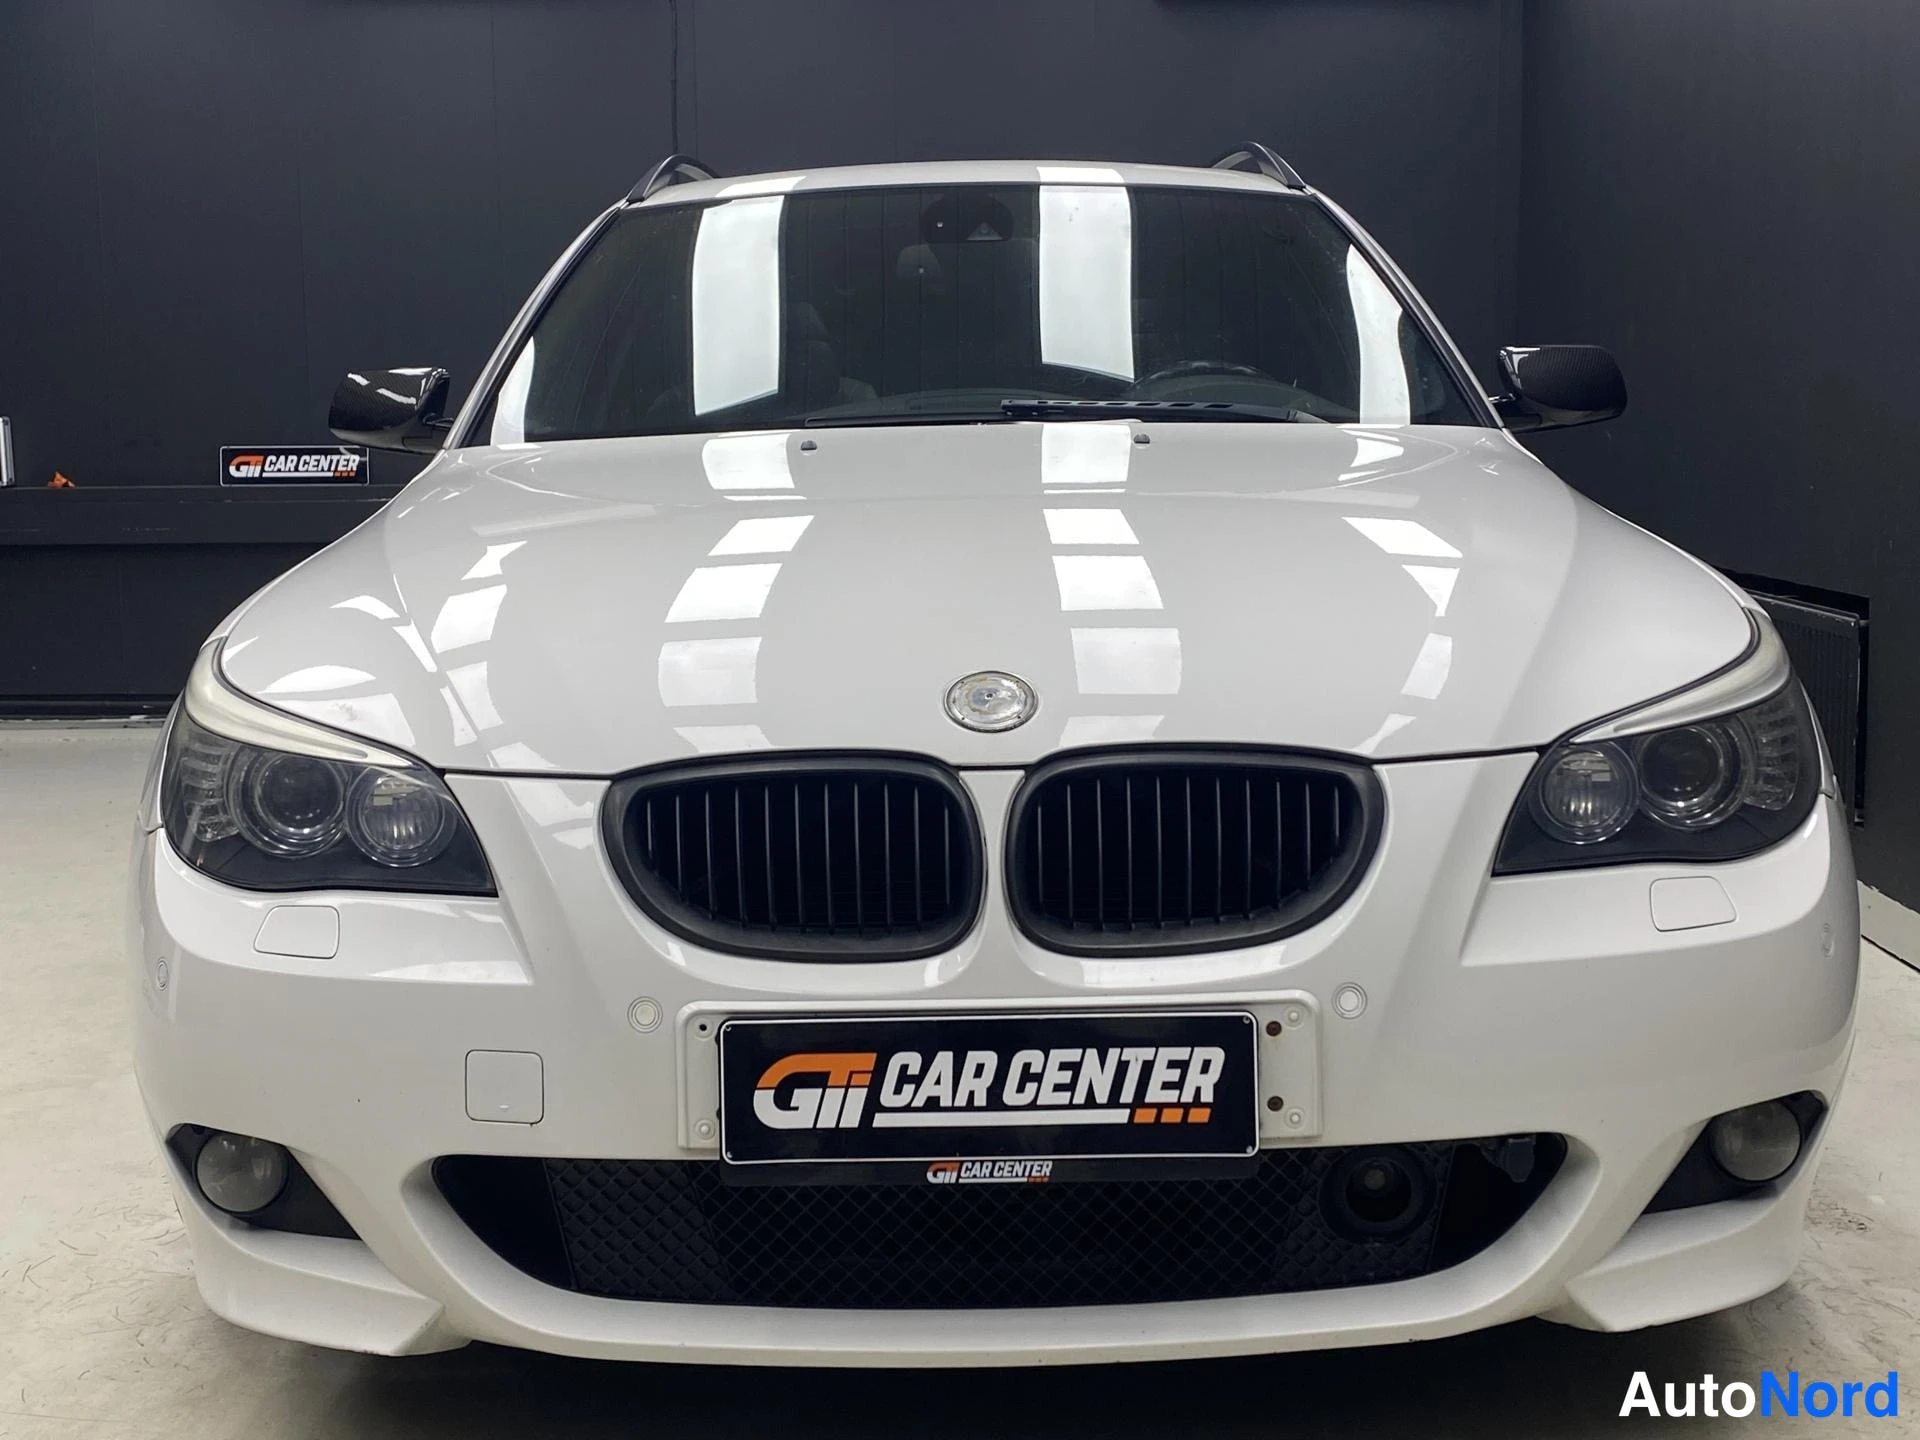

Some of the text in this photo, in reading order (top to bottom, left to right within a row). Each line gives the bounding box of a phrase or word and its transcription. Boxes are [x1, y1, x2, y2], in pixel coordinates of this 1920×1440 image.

[264, 455, 296, 472] CAR
[298, 454, 360, 472] CENTER
[879, 1049, 998, 1108] CAR
[1002, 1046, 1225, 1107] CENTER
[960, 1161, 992, 1178] CAR
[993, 1160, 1053, 1177] CENTER
